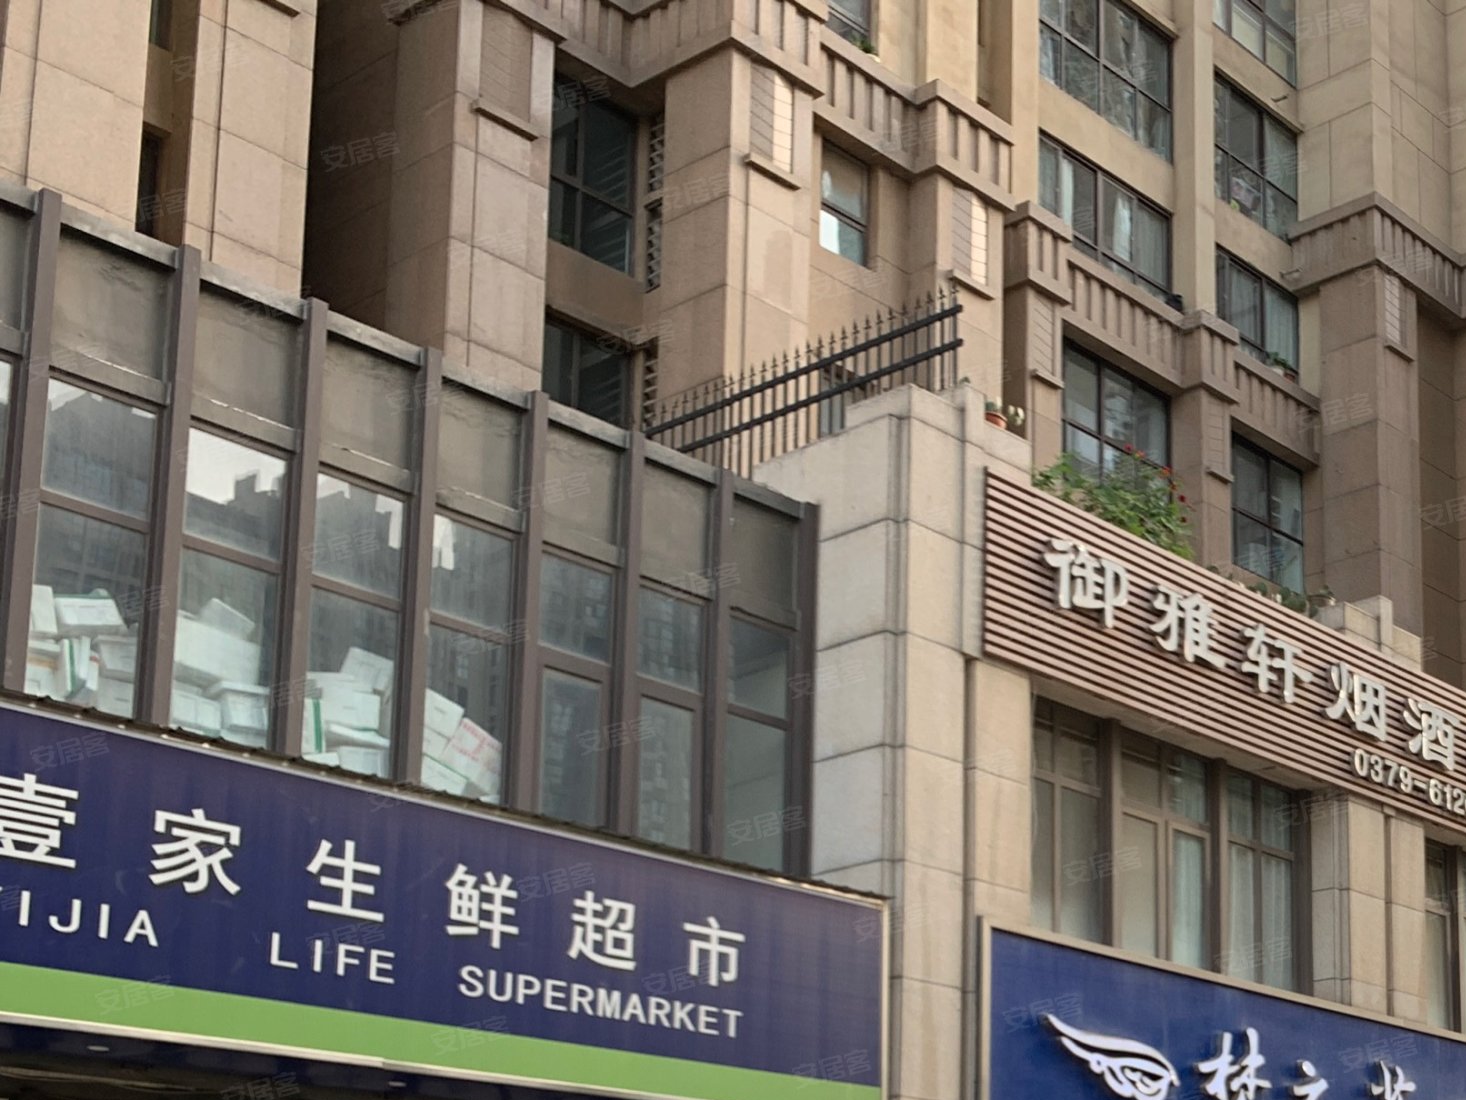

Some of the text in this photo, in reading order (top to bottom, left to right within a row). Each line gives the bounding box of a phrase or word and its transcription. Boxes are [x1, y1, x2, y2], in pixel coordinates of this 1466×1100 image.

[0, 772, 746, 988] 壹家生鲜超市
[0, 886, 744, 1039] IJIA LIFE SUPERMARKET
